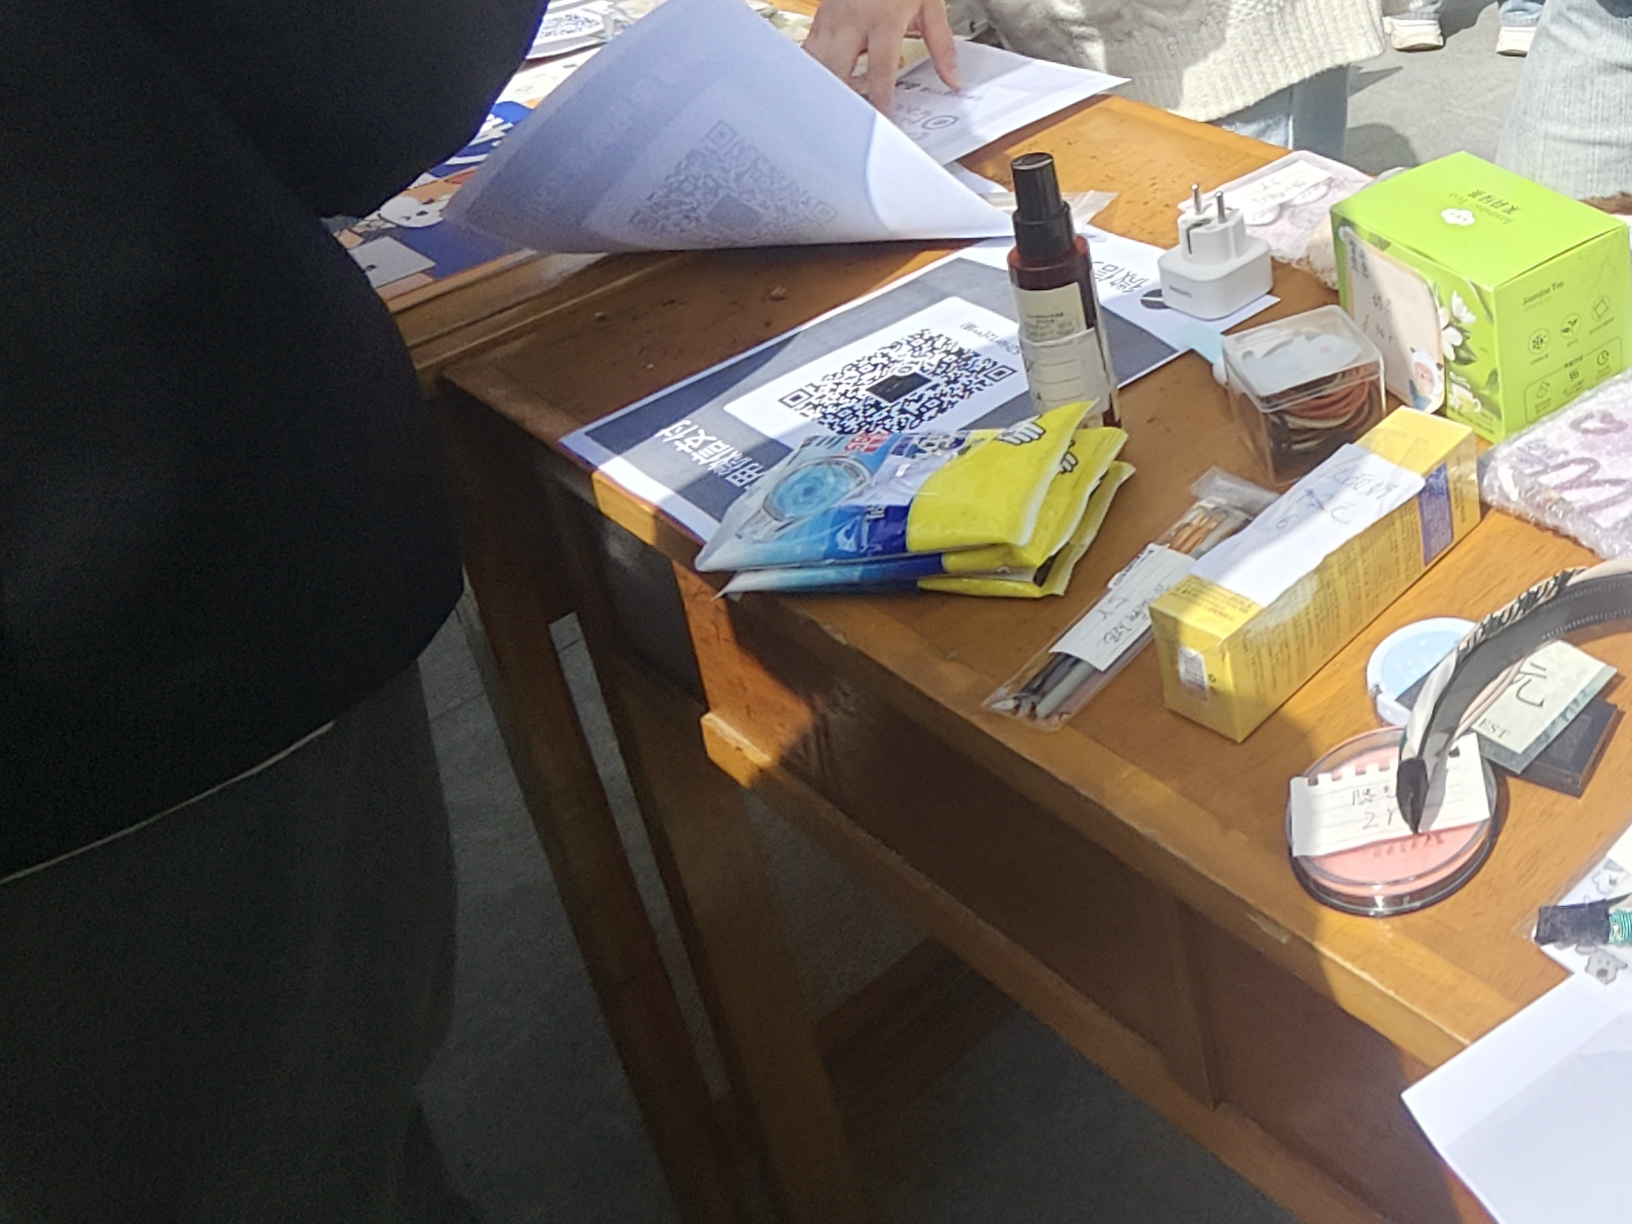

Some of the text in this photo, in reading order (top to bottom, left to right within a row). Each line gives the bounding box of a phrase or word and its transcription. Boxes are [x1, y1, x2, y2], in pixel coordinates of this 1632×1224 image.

[1094, 261, 1150, 294] 微信
[654, 419, 765, 492] 用微信支付
